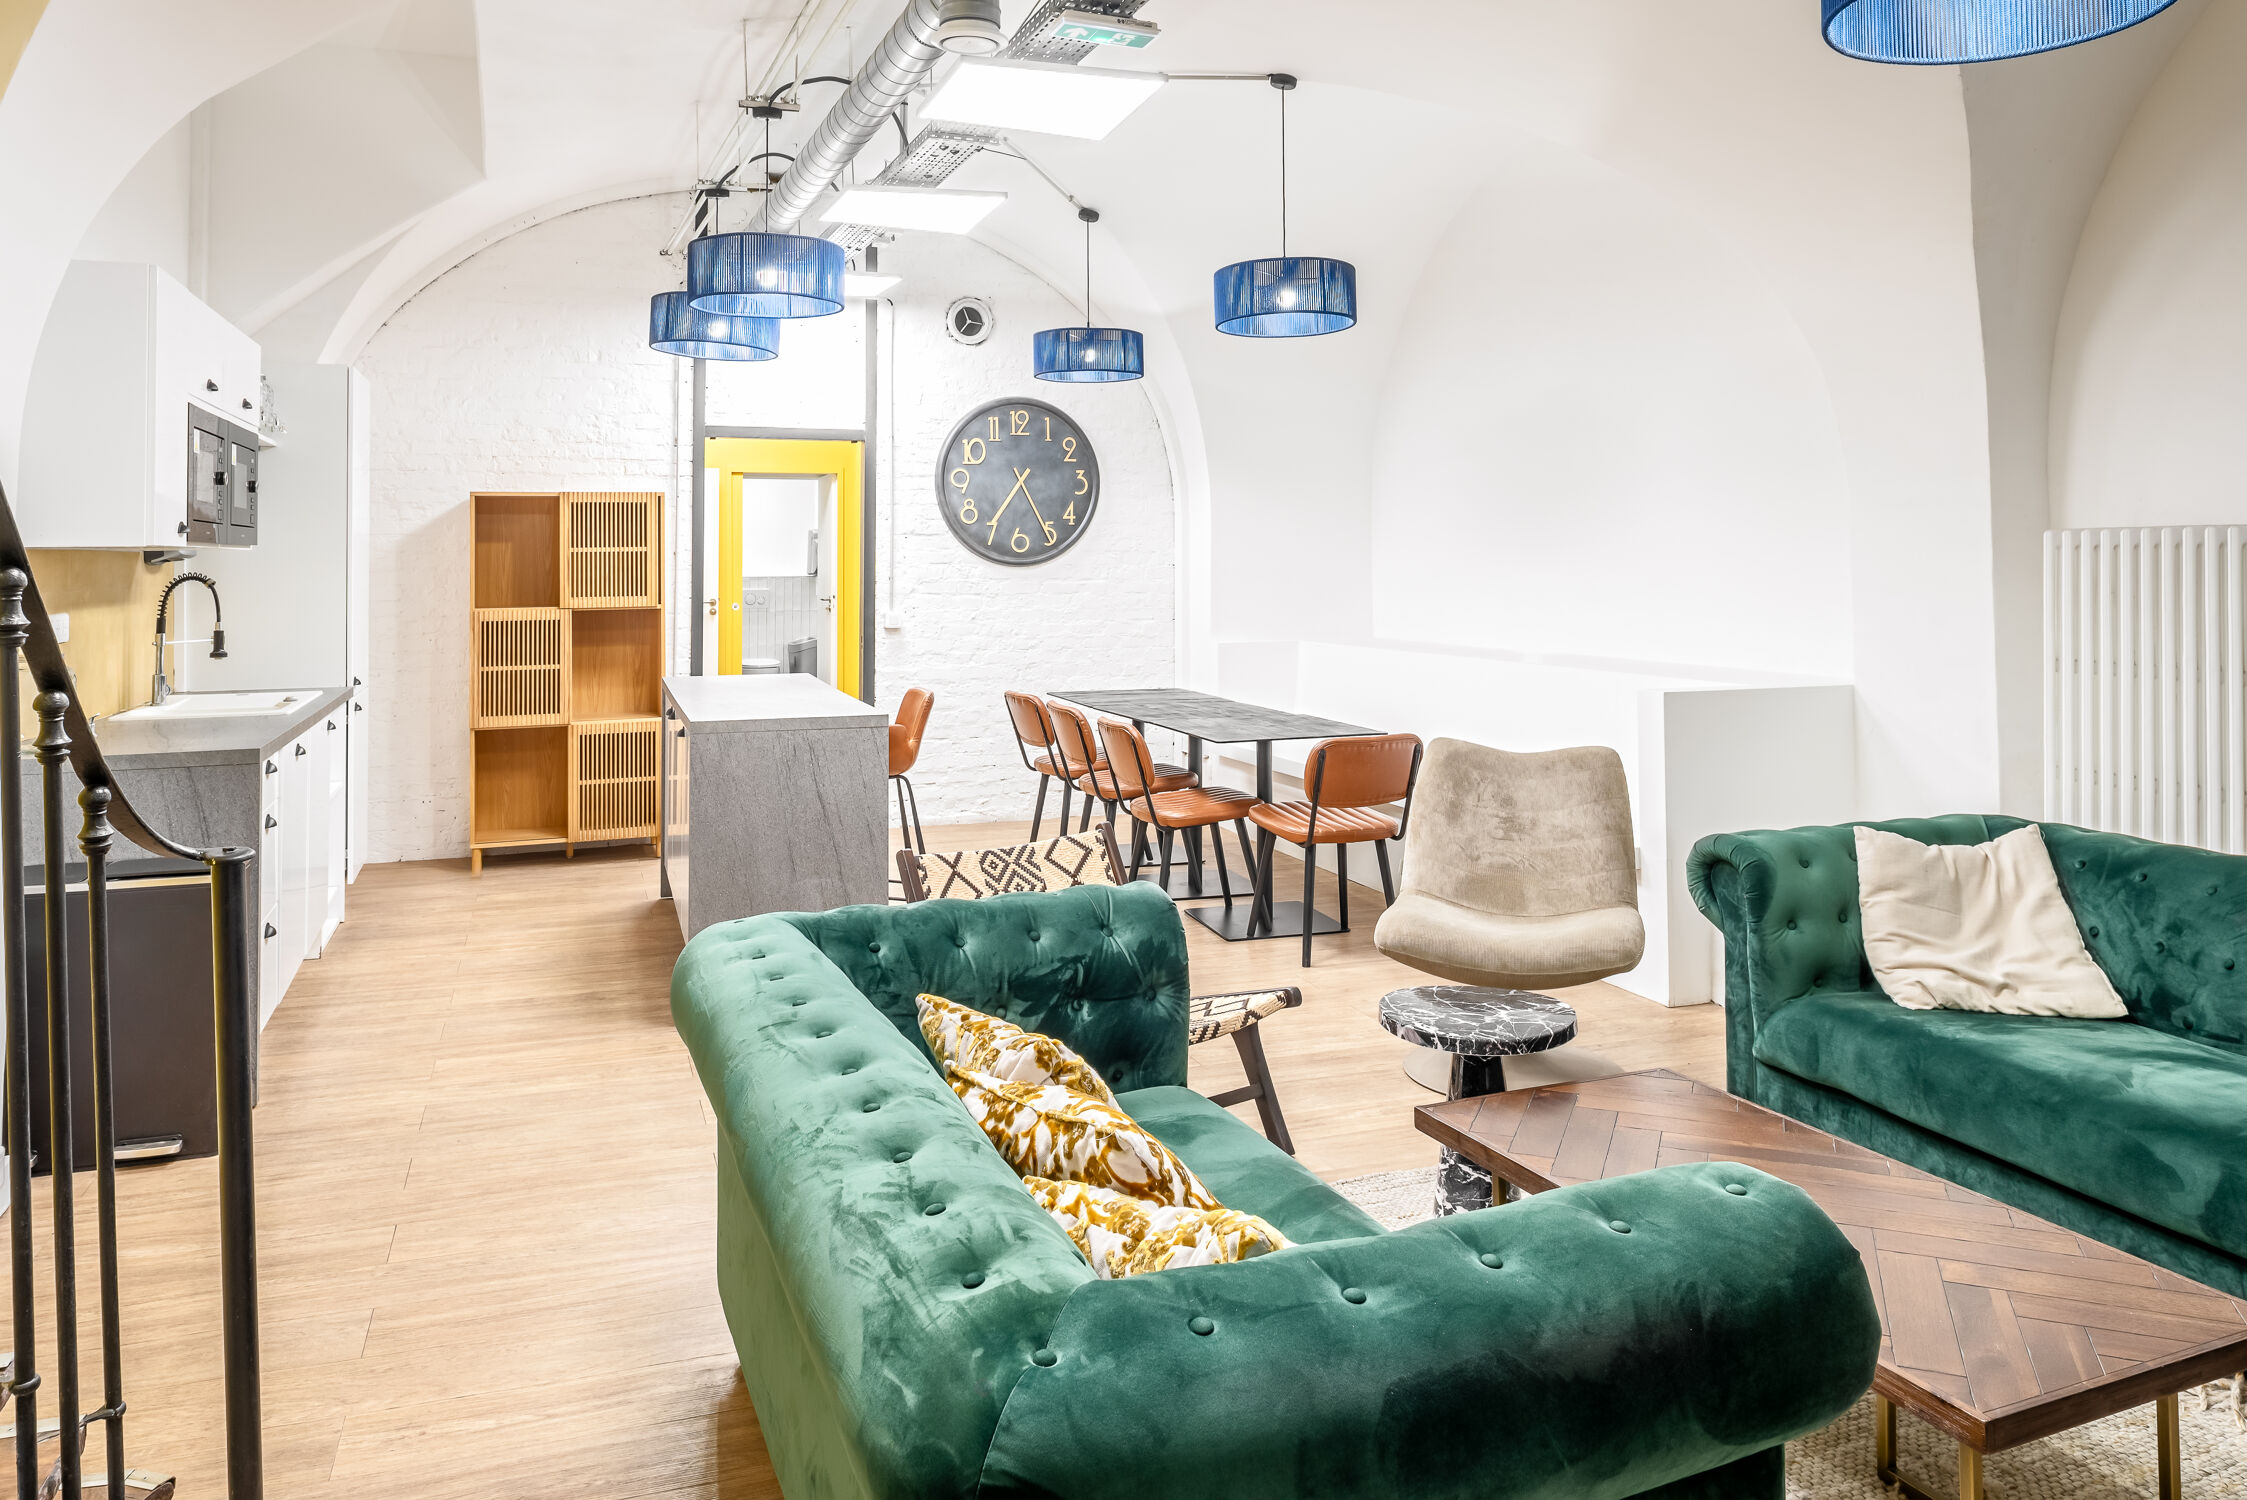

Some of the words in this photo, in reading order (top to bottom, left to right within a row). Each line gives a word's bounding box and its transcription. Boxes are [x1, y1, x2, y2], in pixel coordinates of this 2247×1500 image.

[988, 416, 1001, 442] 11
[1010, 410, 1030, 436] 12
[1044, 416, 1053, 442] 1
[962, 437, 987, 465] 10
[1062, 436, 1077, 463] 2
[950, 468, 970, 494] 9
[1074, 469, 1089, 495] 3
[960, 498, 978, 525] 8
[1062, 501, 1076, 526] 4
[986, 521, 998, 546] 7
[1010, 527, 1030, 553] 6
[1044, 520, 1057, 547] 5
